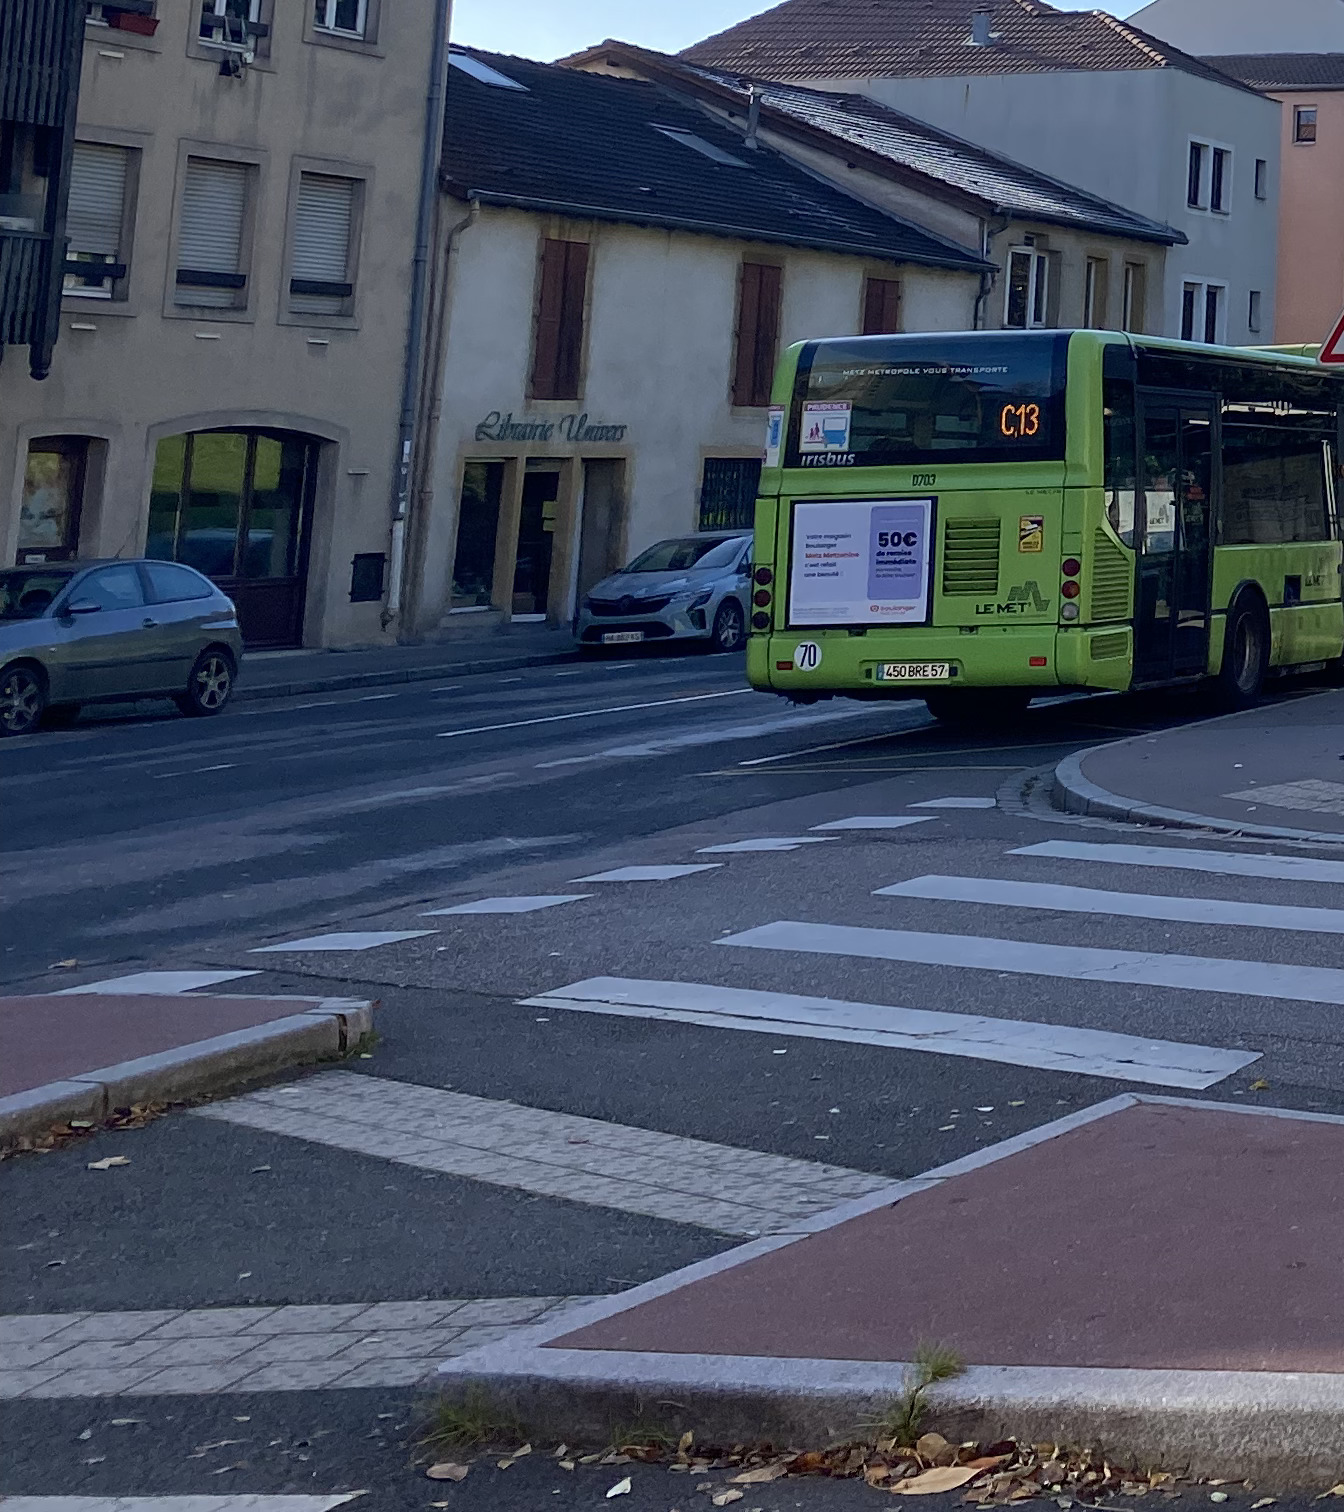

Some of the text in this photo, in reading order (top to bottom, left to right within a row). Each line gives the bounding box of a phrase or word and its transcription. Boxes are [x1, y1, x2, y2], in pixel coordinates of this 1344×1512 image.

[807, 402, 847, 411] PRUDENCE
[475, 411, 628, 442] Librairie Univers
[1000, 403, 1039, 436] C13
[800, 452, 856, 467] irisbus
[912, 474, 936, 486] D703
[878, 531, 918, 548] 50€
[975, 604, 994, 615] LE
[800, 644, 817, 667] 70
[886, 665, 945, 678] 450 BRE 57
